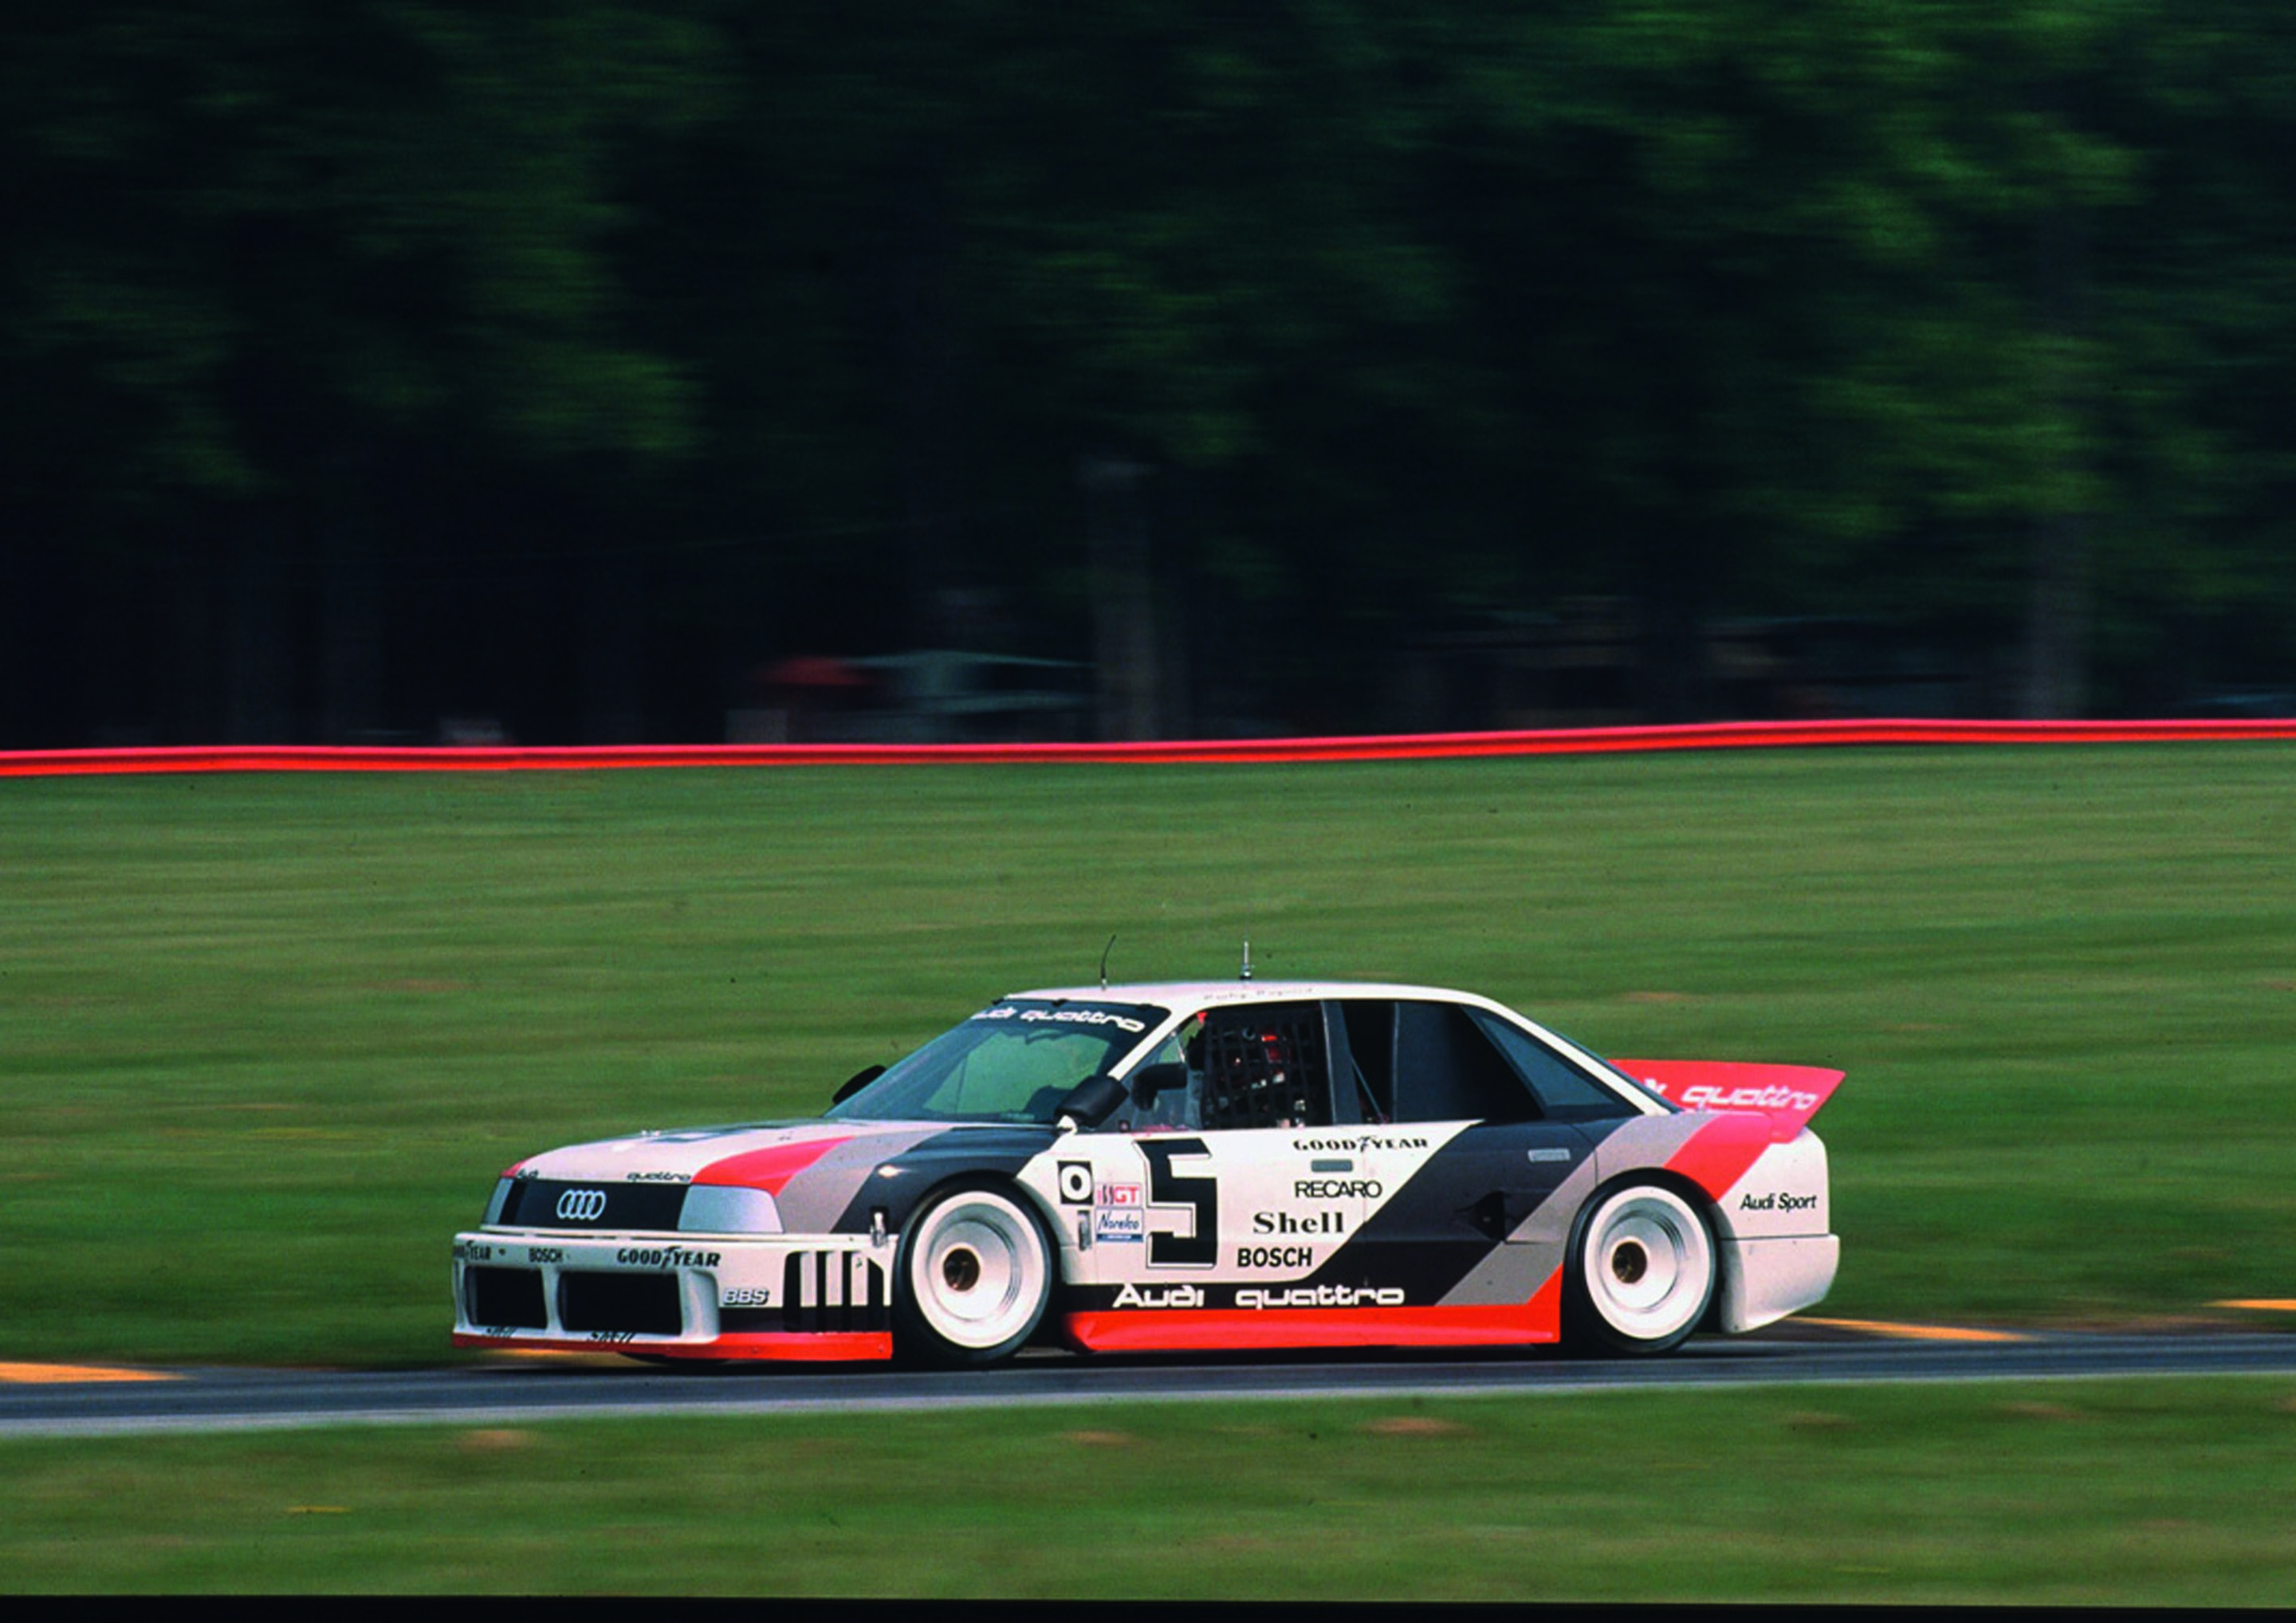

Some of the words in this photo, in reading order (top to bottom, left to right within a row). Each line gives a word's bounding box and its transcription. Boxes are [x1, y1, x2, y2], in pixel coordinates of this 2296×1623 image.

[1020, 1010, 1146, 1032] quattro
[1681, 1083, 1818, 1110] quattro
[1293, 1136, 1428, 1153] GOODYEAR
[626, 1171, 691, 1182] quattro
[1295, 1180, 1383, 1198] RECARO
[1133, 1138, 1217, 1270] 5
[1740, 1193, 1776, 1210] Audi
[1778, 1193, 1817, 1213] Sport
[1253, 1212, 1344, 1234] Shell
[529, 1247, 563, 1263] BOSCH
[617, 1246, 721, 1269] GOODYEAR
[1237, 1247, 1312, 1267] BOSCH
[723, 1288, 769, 1306] BBS
[1113, 1282, 1204, 1307] Audi
[1235, 1284, 1405, 1311] quattro
